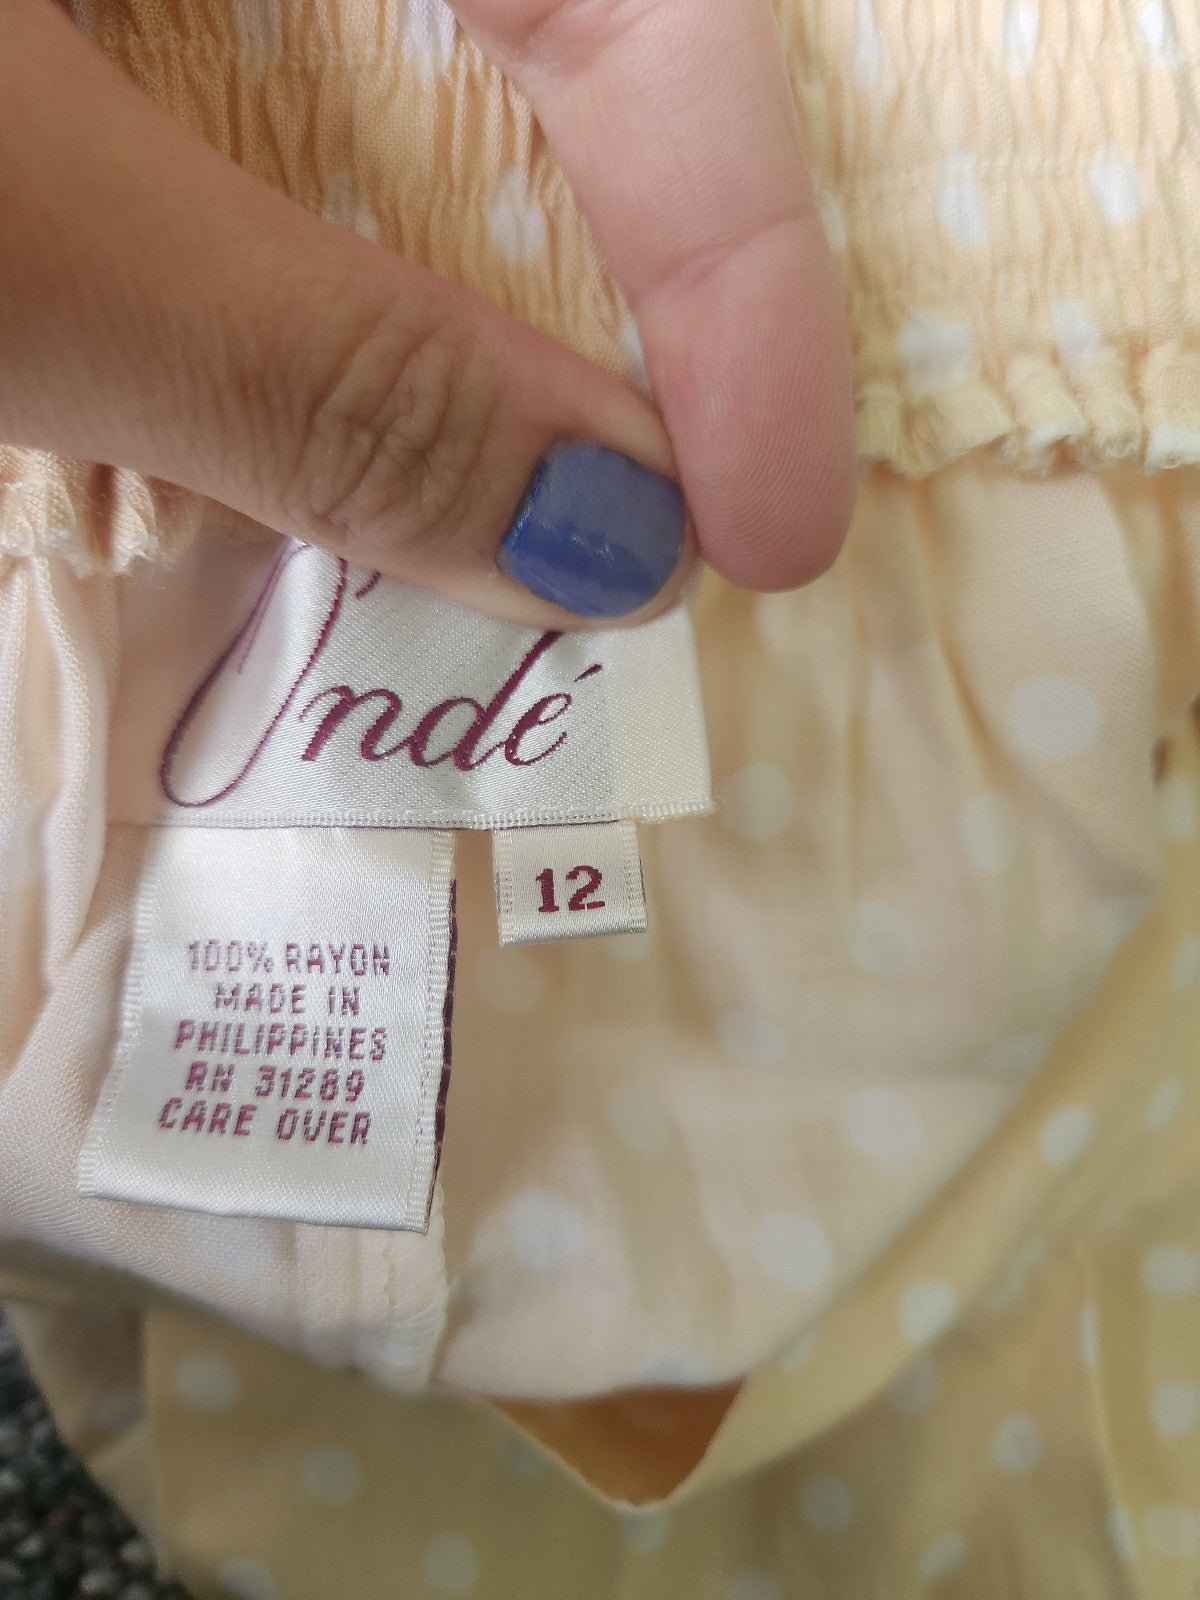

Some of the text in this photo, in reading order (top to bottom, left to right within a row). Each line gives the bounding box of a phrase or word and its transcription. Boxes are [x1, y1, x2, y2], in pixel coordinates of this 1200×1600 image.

[535, 865, 606, 913] 12
[188, 939, 391, 977] 100% RAYON
[213, 982, 361, 1016] MADE IN
[174, 1019, 388, 1061] PHILIPPINES
[185, 1061, 365, 1102] RN 31289
[158, 1097, 372, 1145] CARE OVER
